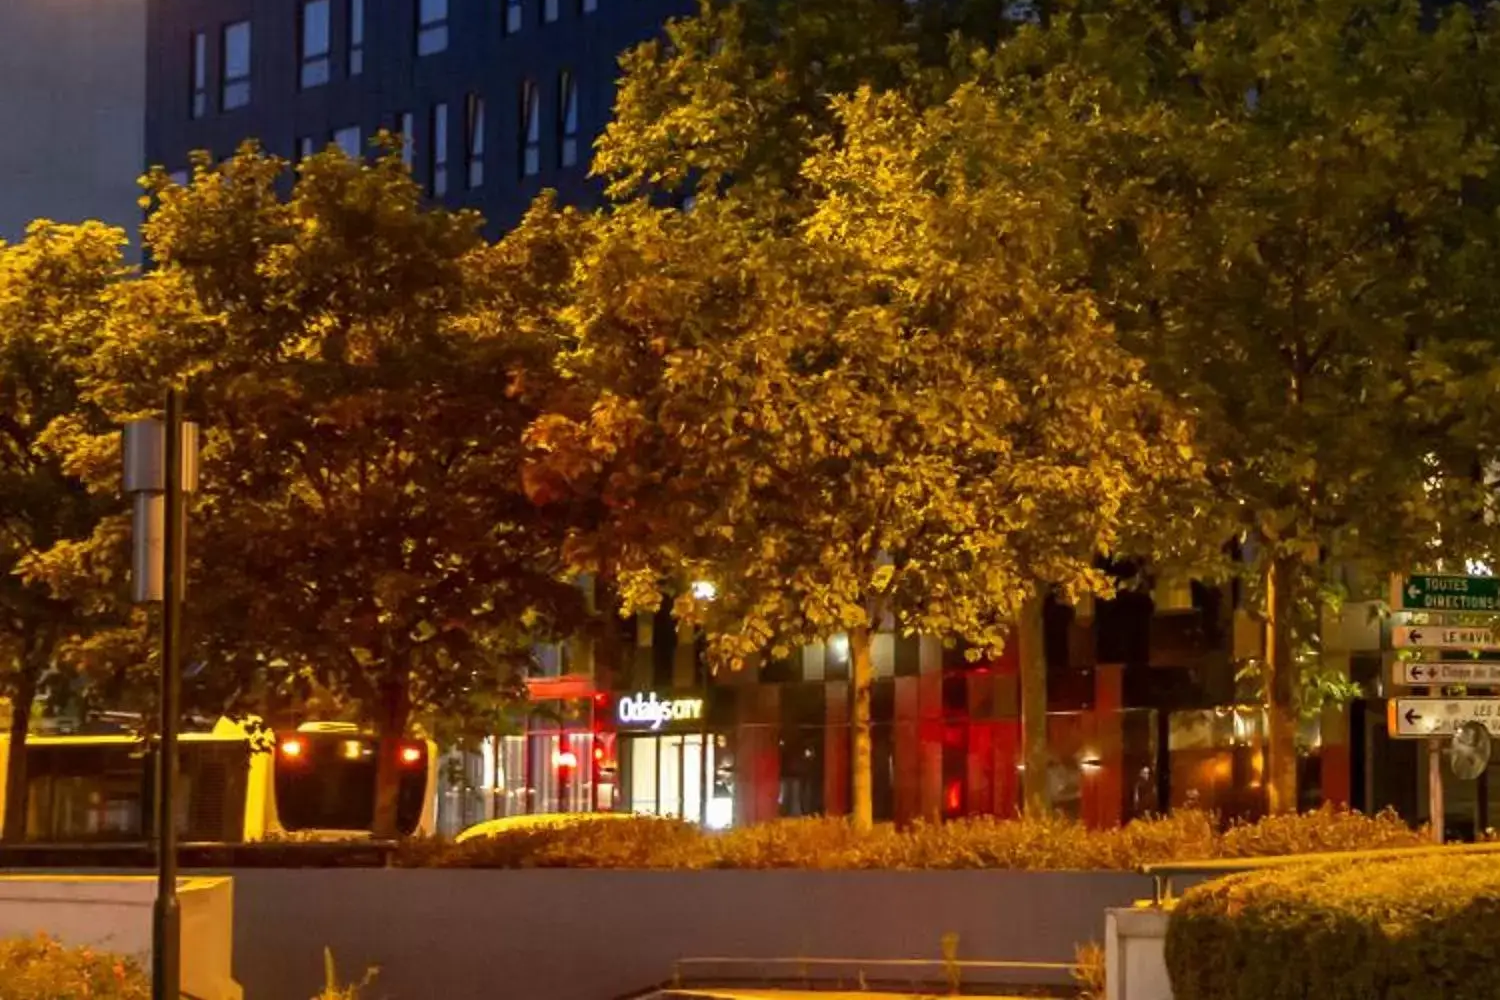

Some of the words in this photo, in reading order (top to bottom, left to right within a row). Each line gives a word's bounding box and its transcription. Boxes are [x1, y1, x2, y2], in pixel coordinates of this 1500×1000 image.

[1424, 577, 1469, 591] TOUTES
[1424, 594, 1495, 610] DIRECTIONS
[1442, 630, 1456, 643] LE
[620, 691, 672, 729] Odalys
[672, 698, 704, 720] CITY
